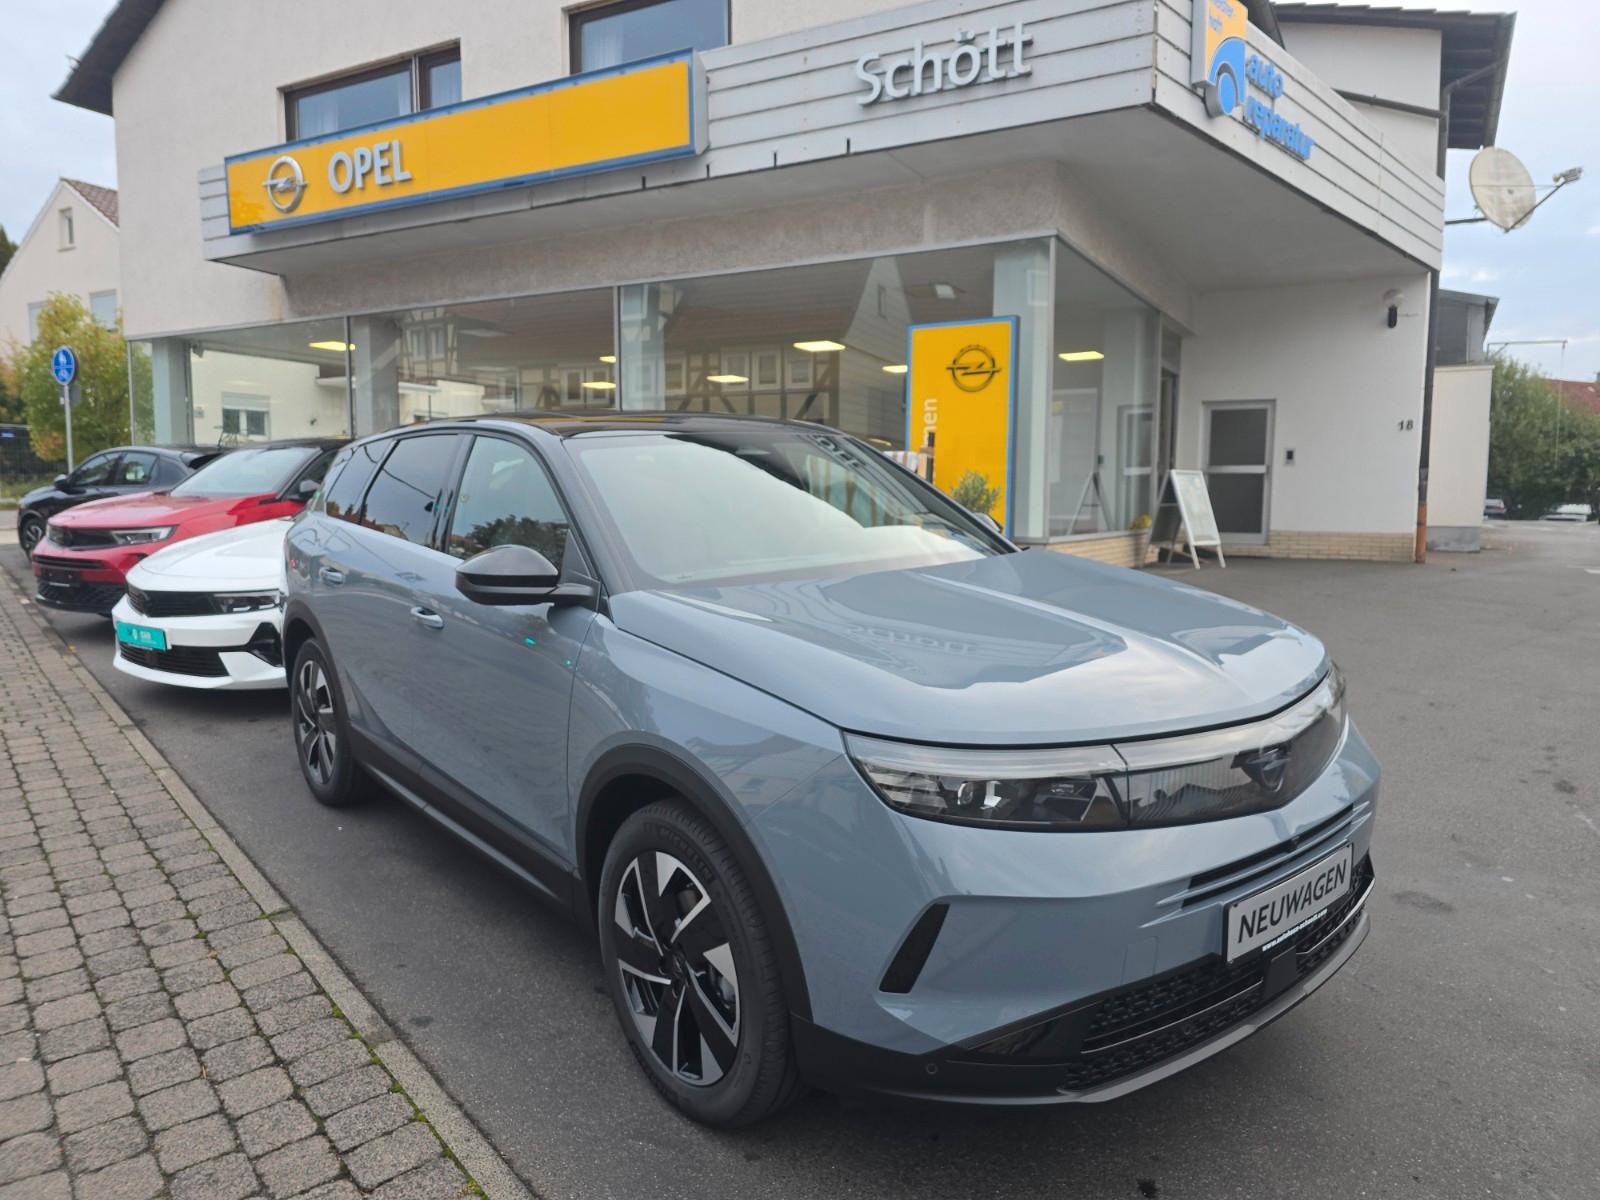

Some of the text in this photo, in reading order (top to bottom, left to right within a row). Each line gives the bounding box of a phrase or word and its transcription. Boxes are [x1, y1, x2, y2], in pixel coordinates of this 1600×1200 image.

[856, 22, 1033, 105] Schött
[328, 140, 412, 194] OPEL
[1398, 419, 1414, 431] 18
[1238, 859, 1347, 944] NEUWAGEN
